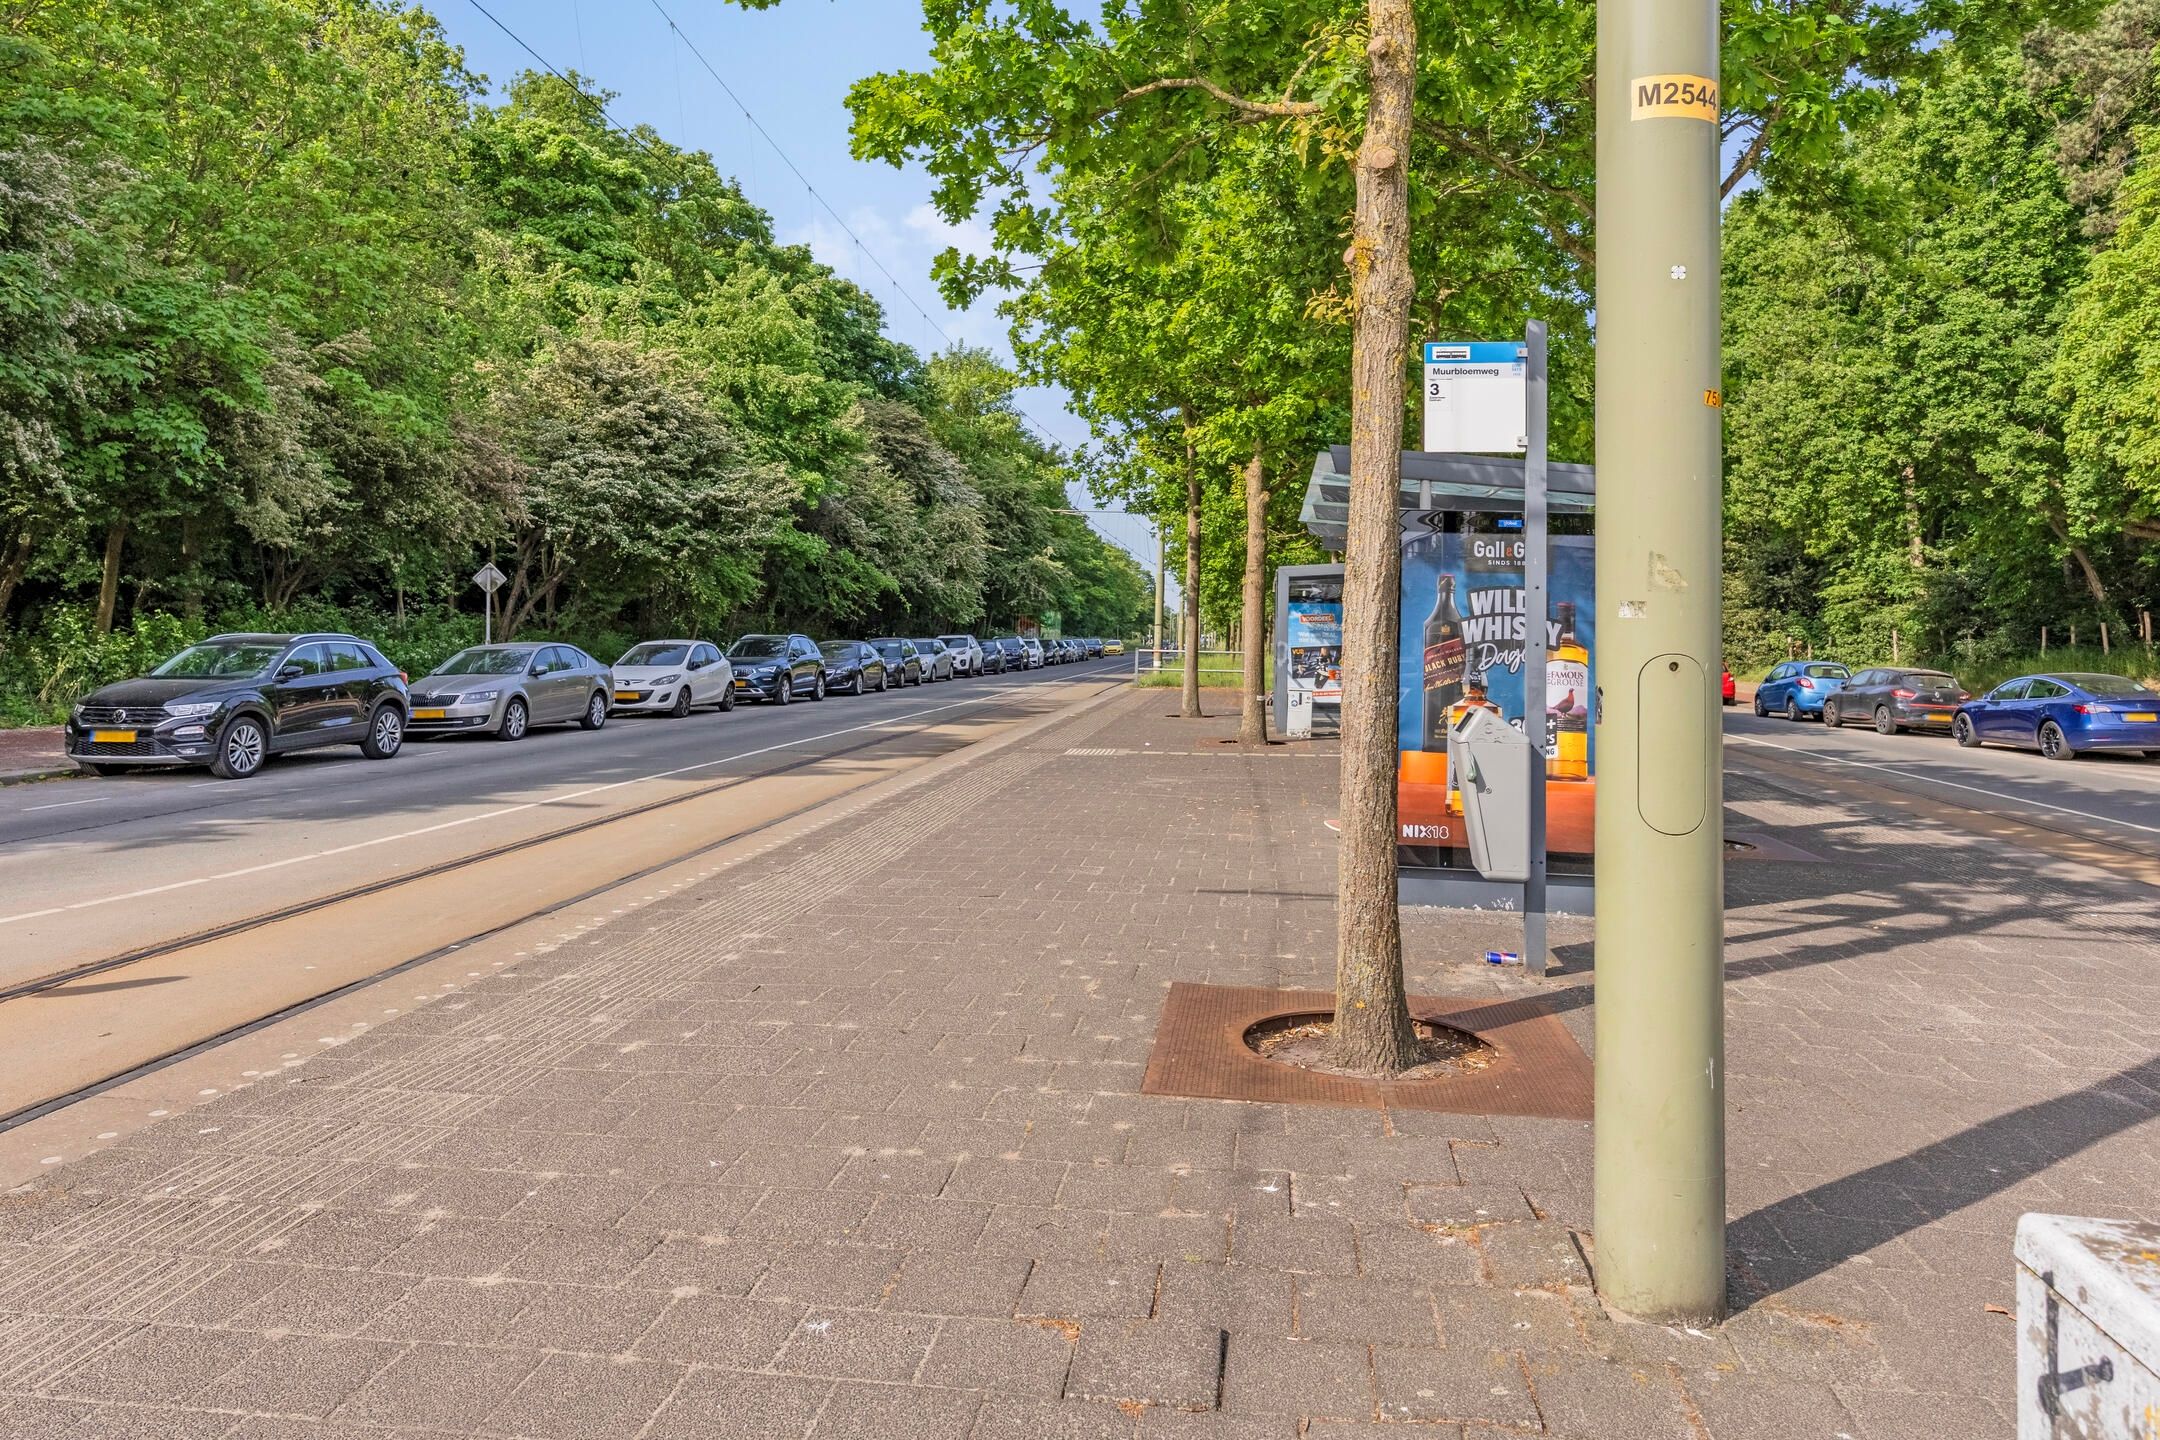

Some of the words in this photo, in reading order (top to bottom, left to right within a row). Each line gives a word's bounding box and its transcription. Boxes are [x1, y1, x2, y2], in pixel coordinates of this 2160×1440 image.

[1638, 82, 1717, 111] M2544
[1432, 367, 1499, 377] Muurbloemweg
[1430, 383, 1440, 396] 3
[1705, 389, 1721, 408] 75
[1470, 589, 1525, 616] WILD
[1461, 616, 1562, 647] WHISY
[1447, 653, 1465, 665] RUBY
[1477, 642, 1526, 673] Dag
[1550, 679, 1584, 687] GROUSE
[1551, 671, 1584, 680] FAMOUS
[1402, 824, 1449, 839] NIX18
